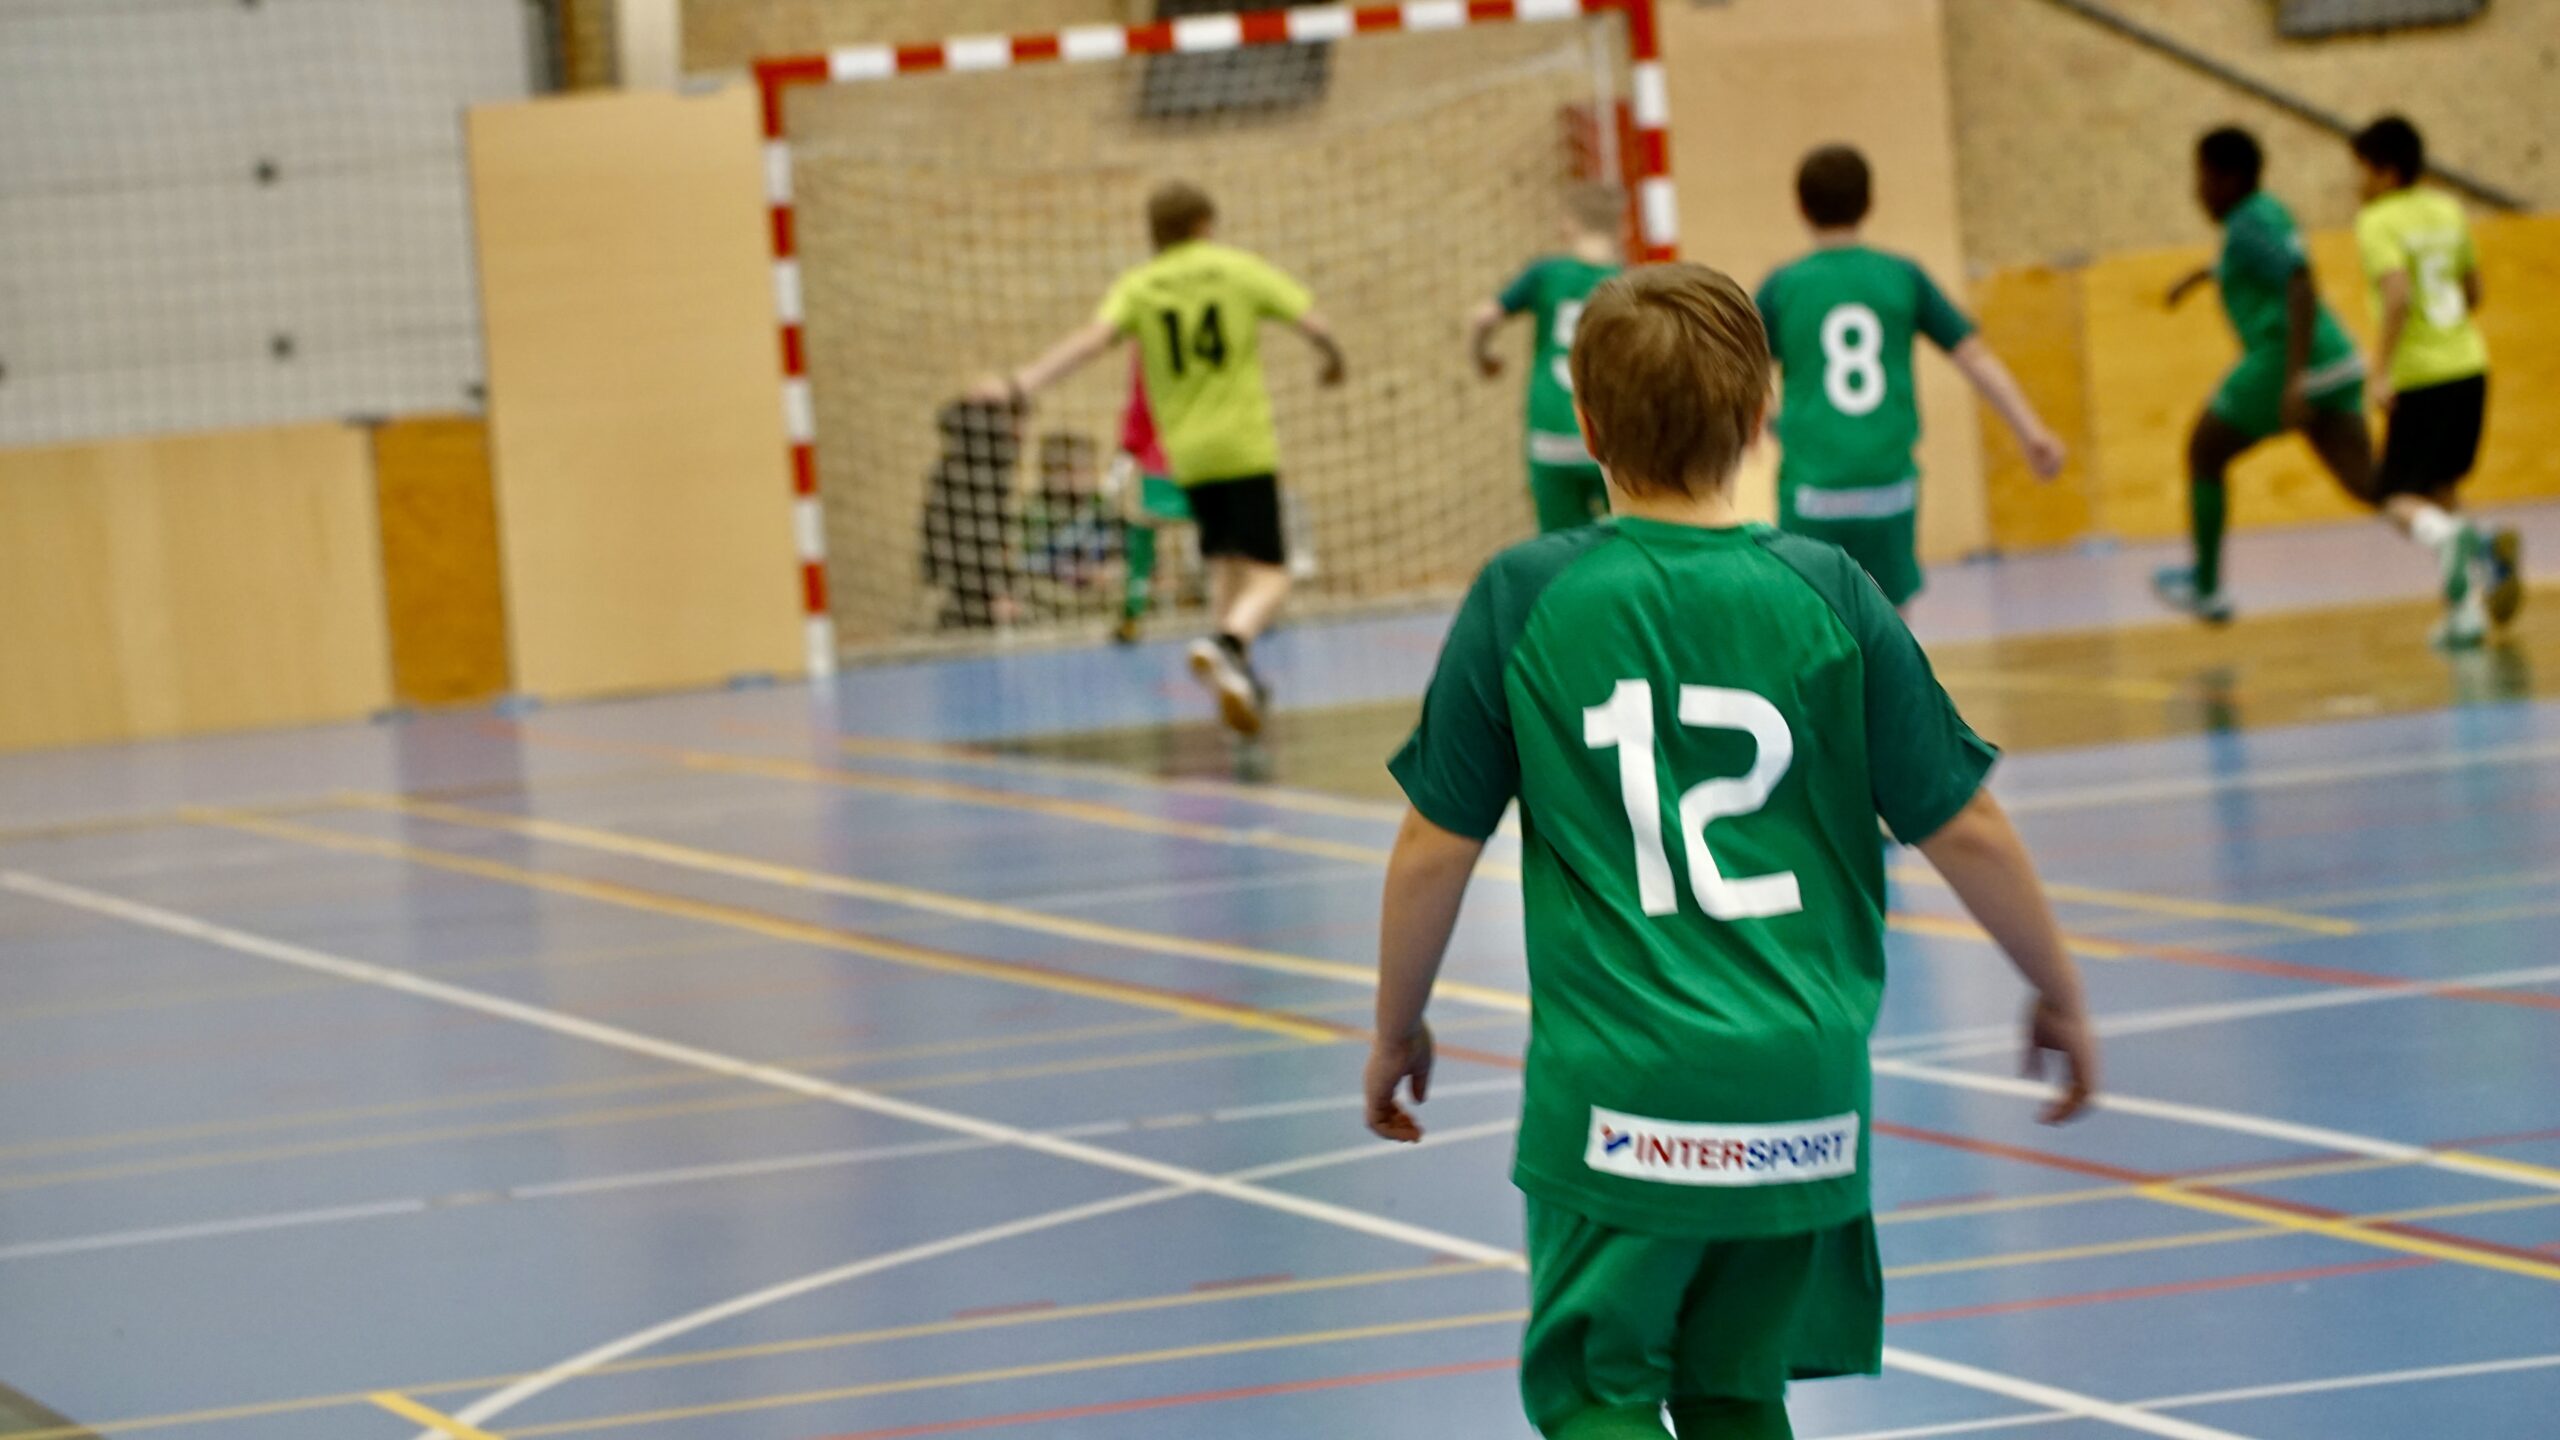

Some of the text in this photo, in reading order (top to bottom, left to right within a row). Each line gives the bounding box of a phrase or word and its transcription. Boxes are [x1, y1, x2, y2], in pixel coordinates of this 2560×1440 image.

[1160, 302, 1227, 376] 14
[1820, 302, 1886, 416] 8
[1583, 678, 1803, 921] 12
[1634, 1128, 1846, 1171] INTERSPORT
